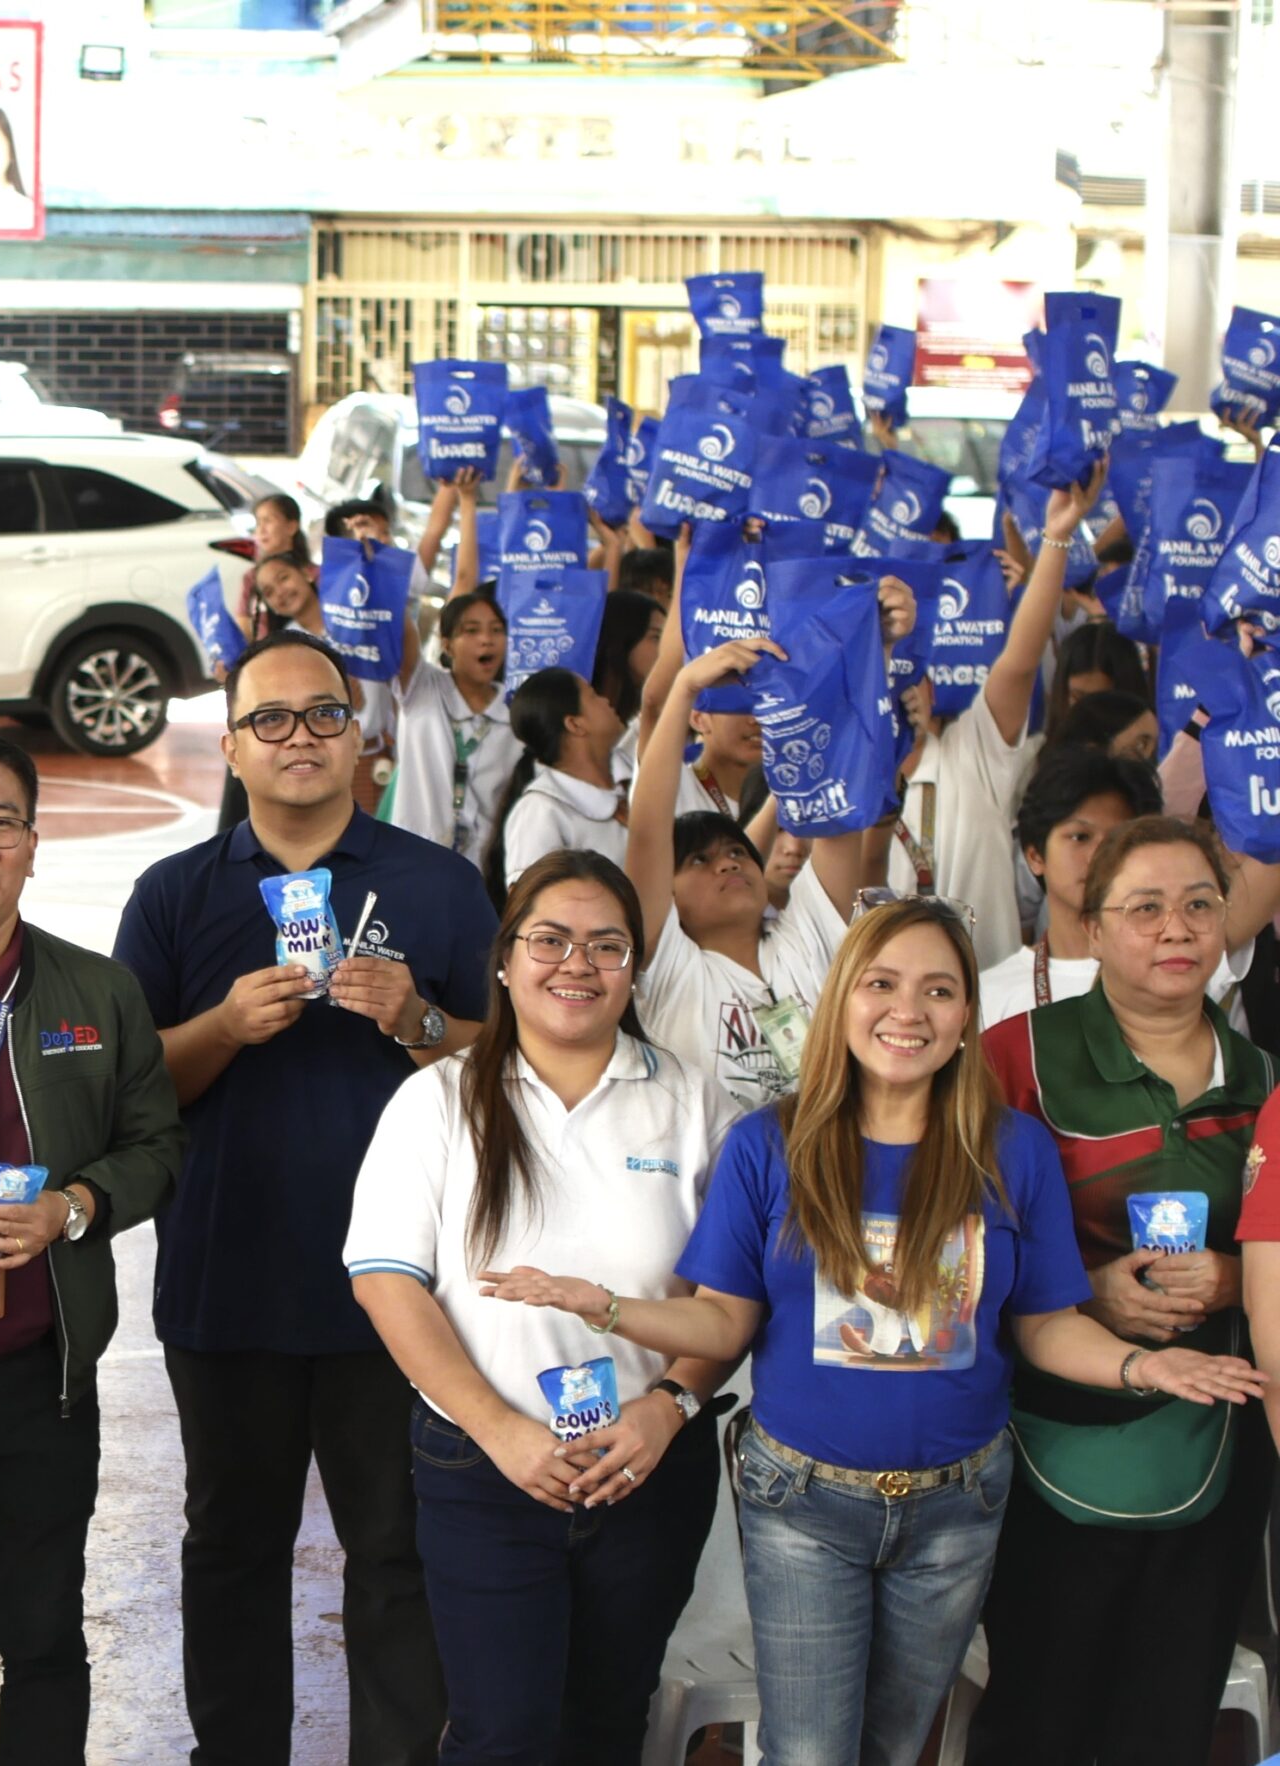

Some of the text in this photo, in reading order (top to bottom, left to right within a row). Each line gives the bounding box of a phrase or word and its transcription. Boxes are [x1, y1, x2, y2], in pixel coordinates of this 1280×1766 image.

[694, 607, 755, 627] MANILA
[955, 620, 1004, 636] WATER
[281, 912, 331, 938] COW'S
[287, 933, 332, 953] MILK
[377, 943, 405, 961] WATER
[39, 1024, 100, 1049] DepED
[555, 1399, 612, 1429] COW'S
